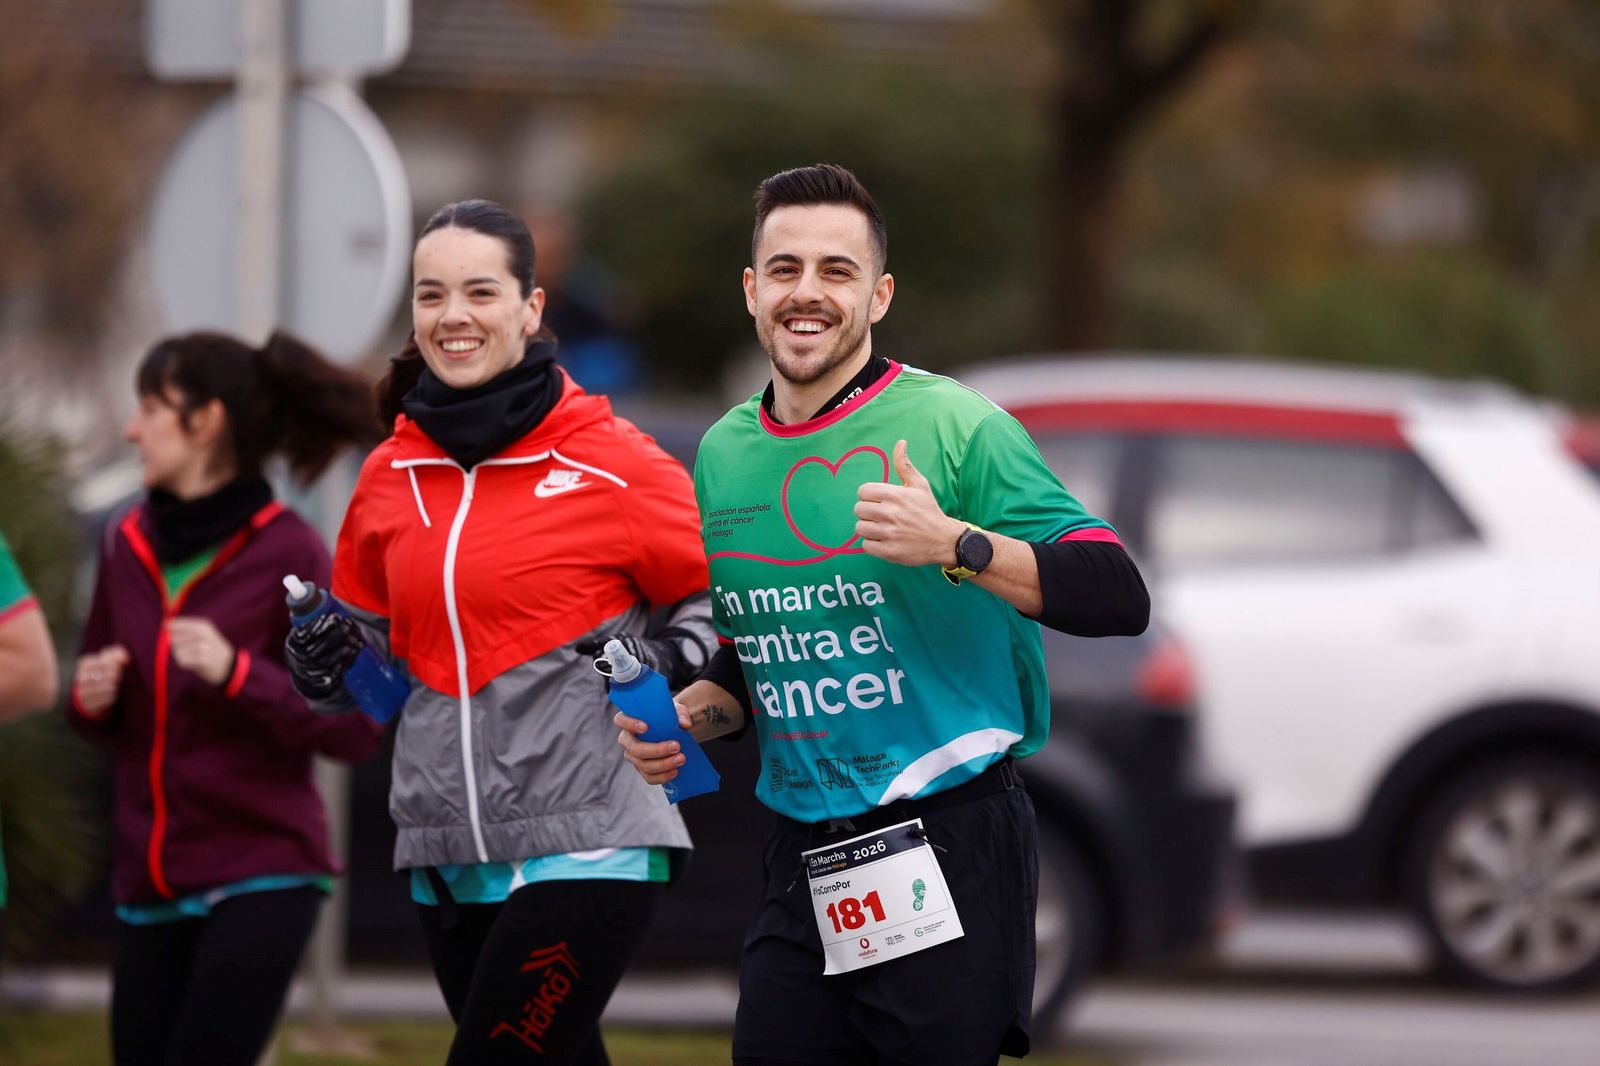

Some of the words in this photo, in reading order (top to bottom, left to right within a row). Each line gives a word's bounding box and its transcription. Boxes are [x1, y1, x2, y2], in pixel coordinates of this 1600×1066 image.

[543, 469, 583, 487] NIKE
[738, 503, 771, 515] española
[748, 574, 885, 613] marcha
[734, 625, 844, 664] contra
[850, 616, 894, 655] el
[817, 851, 847, 866] Marcha
[853, 840, 886, 860] 2026
[826, 890, 887, 934] 181
[858, 948, 878, 957] vodafone
